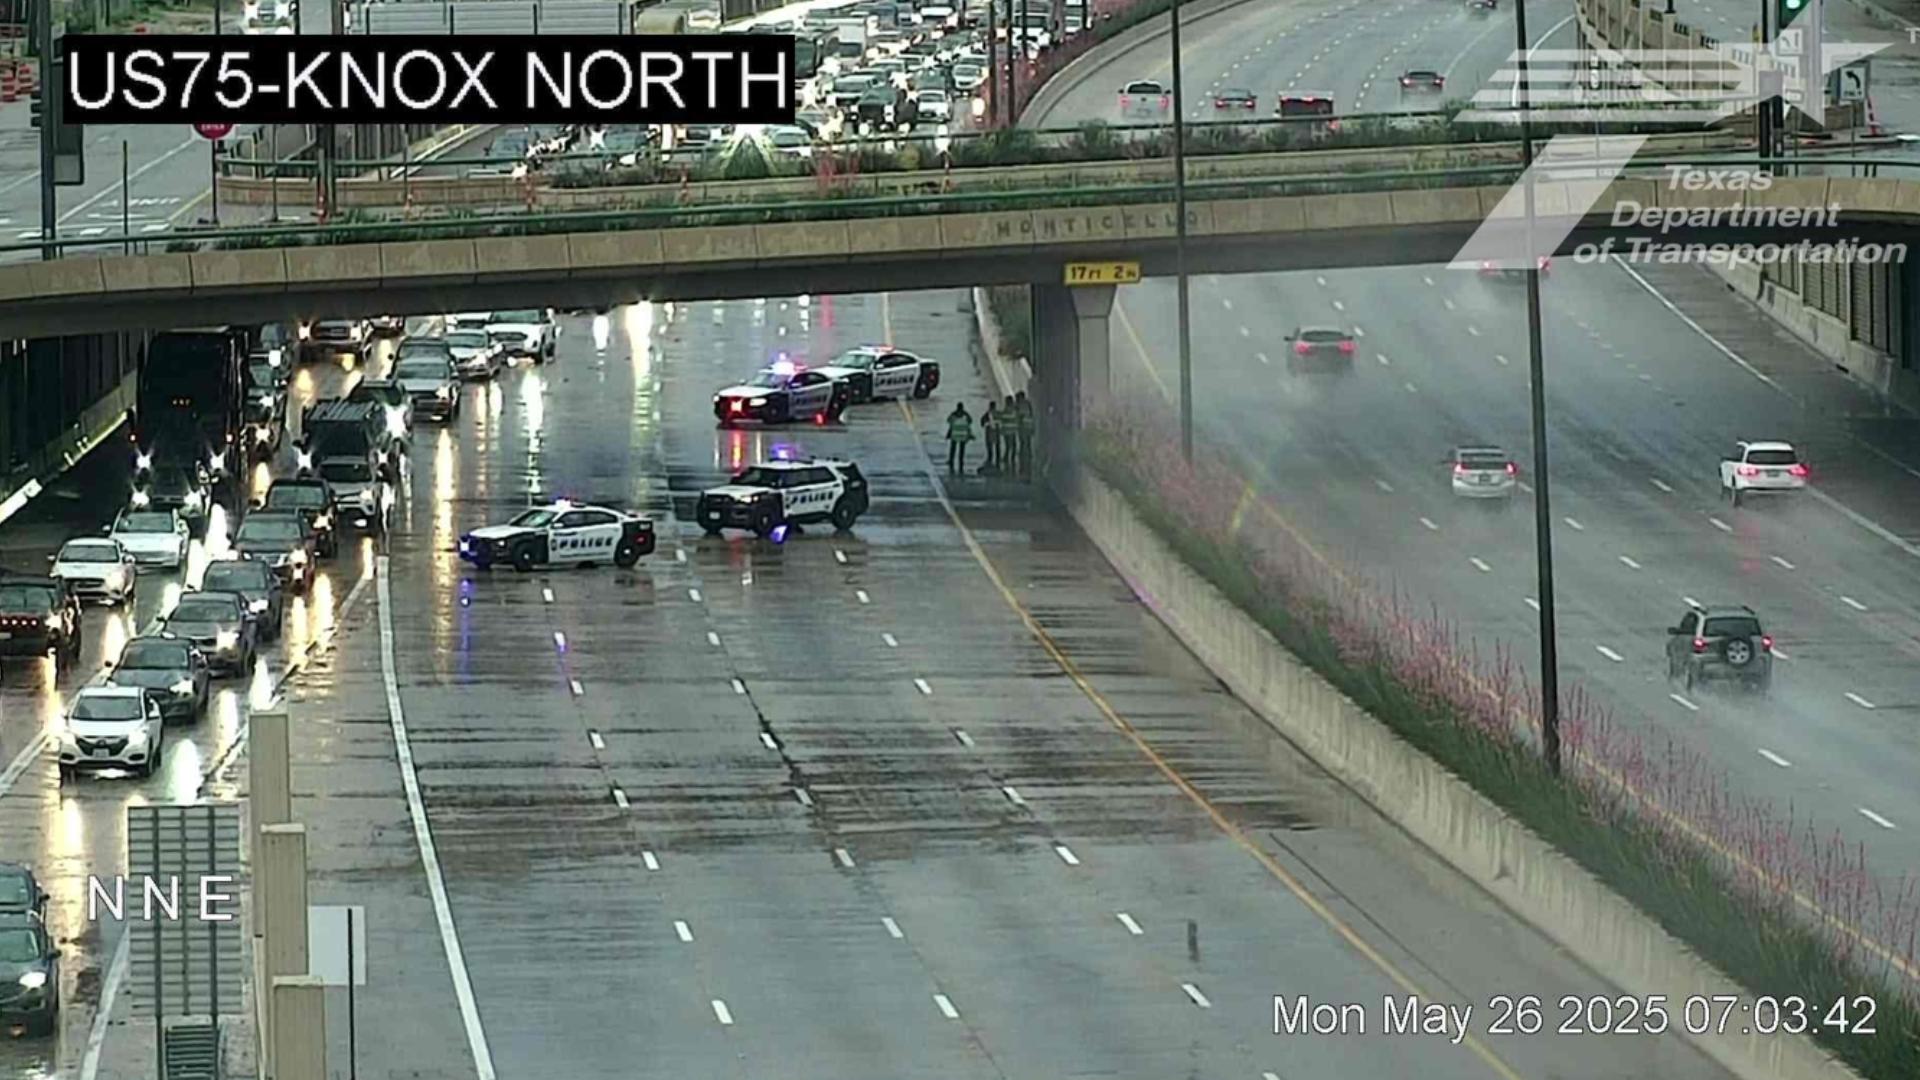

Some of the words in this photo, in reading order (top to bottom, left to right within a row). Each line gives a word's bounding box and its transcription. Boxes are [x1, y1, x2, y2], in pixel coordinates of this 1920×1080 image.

[996, 210, 1198, 232] MONTICELLO
[791, 491, 834, 504] POLICE
[559, 537, 614, 549] POLICE
